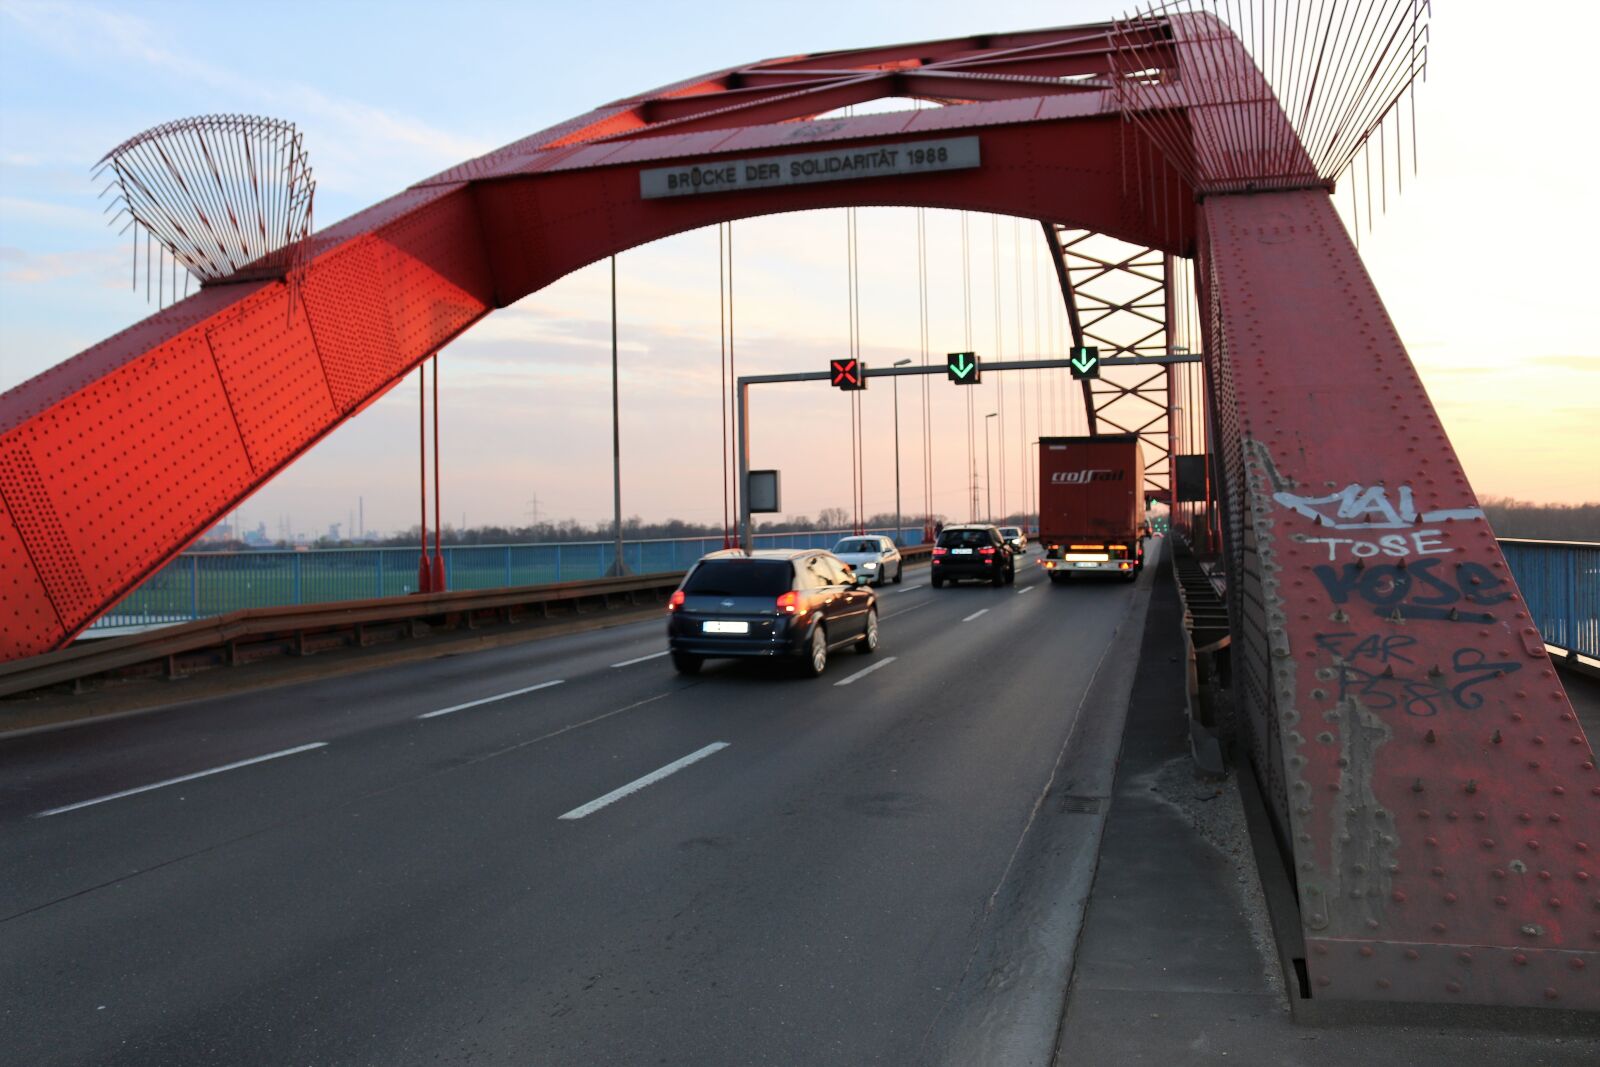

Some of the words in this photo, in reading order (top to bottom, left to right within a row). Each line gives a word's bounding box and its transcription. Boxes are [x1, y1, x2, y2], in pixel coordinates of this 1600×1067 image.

[744, 164, 781, 182] DER
[789, 149, 900, 177] SOLIDARITÄT
[905, 146, 949, 165] 1988
[1305, 530, 1455, 561] TOSE
